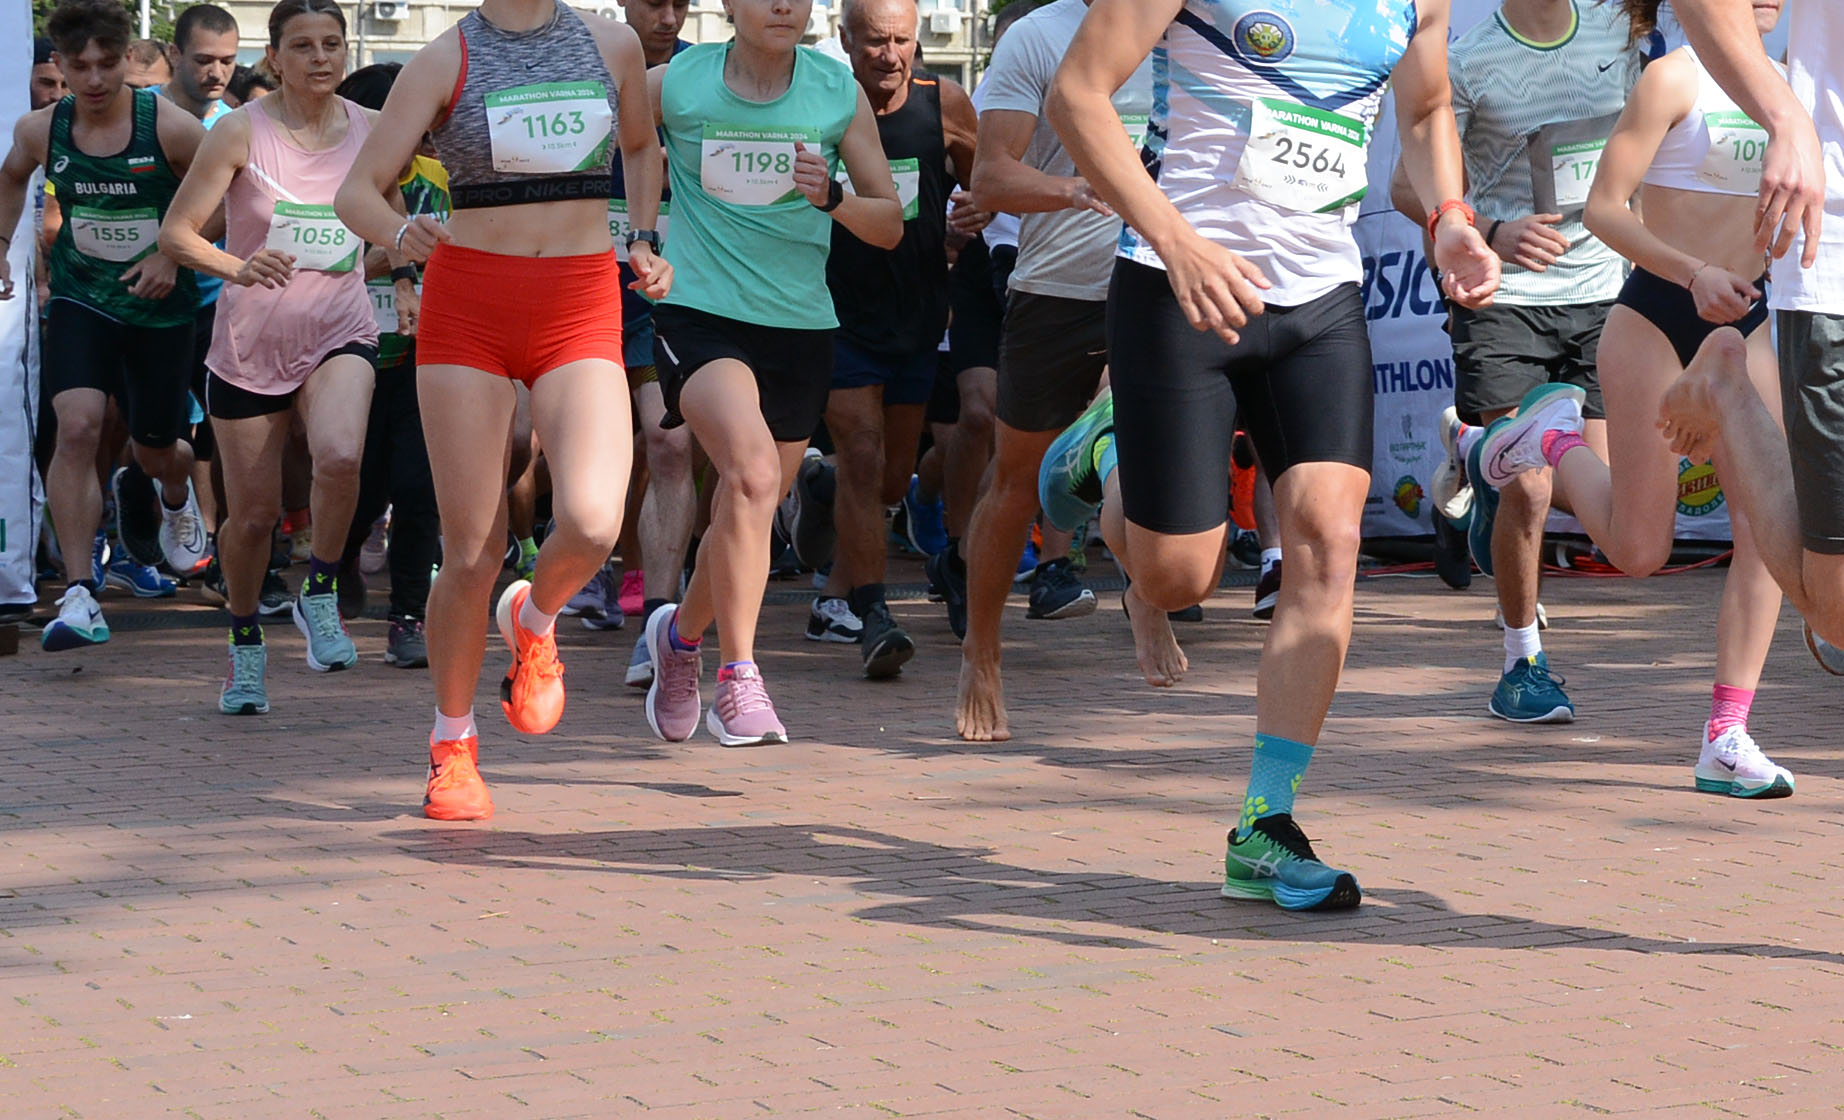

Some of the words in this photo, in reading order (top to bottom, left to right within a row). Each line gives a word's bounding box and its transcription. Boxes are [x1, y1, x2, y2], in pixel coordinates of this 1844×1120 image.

[499, 89, 549, 103] MARATHON
[549, 90, 576, 98] VARNA
[522, 111, 585, 139] 1163
[715, 129, 761, 139] MARATHON
[762, 130, 789, 140] VARNA
[1271, 137, 1345, 178] 2564
[1733, 139, 1765, 161] 101
[731, 152, 790, 174] 1198
[1571, 158, 1600, 181] 17
[74, 182, 138, 195] BULGARIA
[524, 182, 580, 199] NIKE
[91, 227, 140, 241] 1555
[292, 227, 346, 246] 1058
[375, 294, 393, 309] 11
[1373, 358, 1453, 395] THLON
